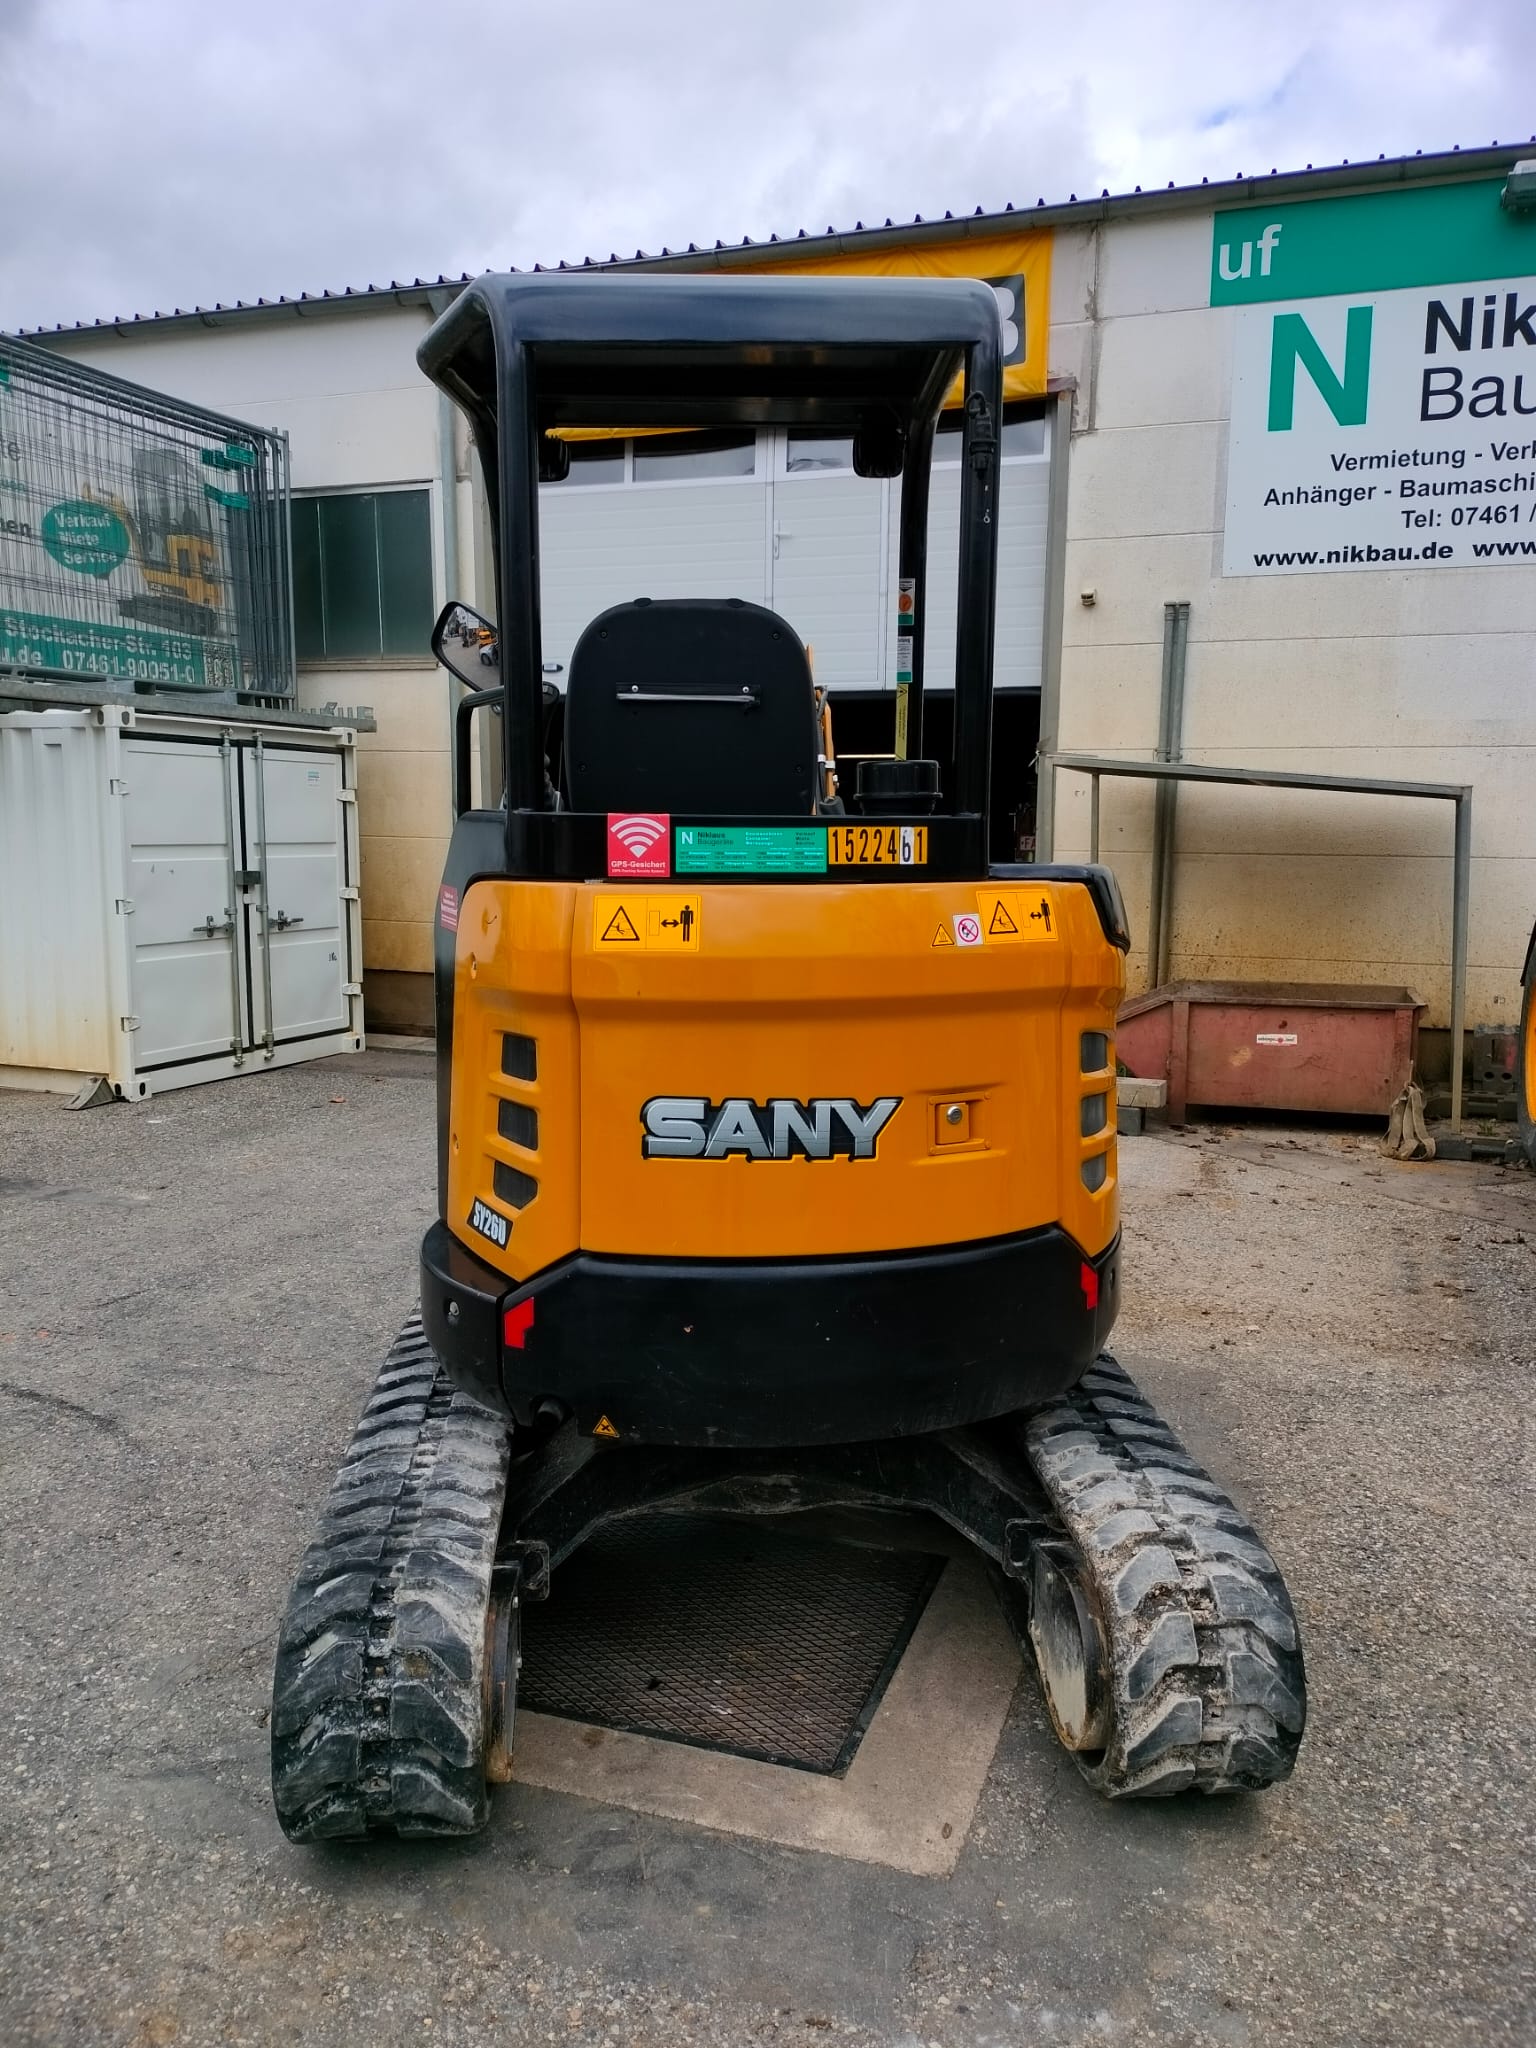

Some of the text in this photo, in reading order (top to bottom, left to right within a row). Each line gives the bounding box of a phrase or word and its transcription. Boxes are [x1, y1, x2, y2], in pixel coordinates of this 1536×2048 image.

[1218, 224, 1283, 281] uf
[1424, 292, 1536, 354] Nik
[1267, 305, 1374, 432] N
[1420, 366, 1536, 421] Bau
[1330, 449, 1466, 471] Vermietung
[1264, 485, 1377, 507] Anhänger
[1400, 472, 1536, 498] Baumaschi
[54, 512, 111, 529] Verkauf
[1401, 508, 1441, 528] Tel:
[1451, 504, 1519, 526] 07461
[58, 531, 99, 547] Miete
[1253, 541, 1453, 566] www.nikbau.de
[63, 550, 118, 565] Service
[62, 650, 195, 684] 07461-90051-0
[681, 831, 693, 845] N
[832, 828, 923, 863] 1522461
[611, 860, 666, 869] GPS-Gesichert
[642, 1097, 903, 1161] SANY
[473, 1201, 507, 1246] SY26U
